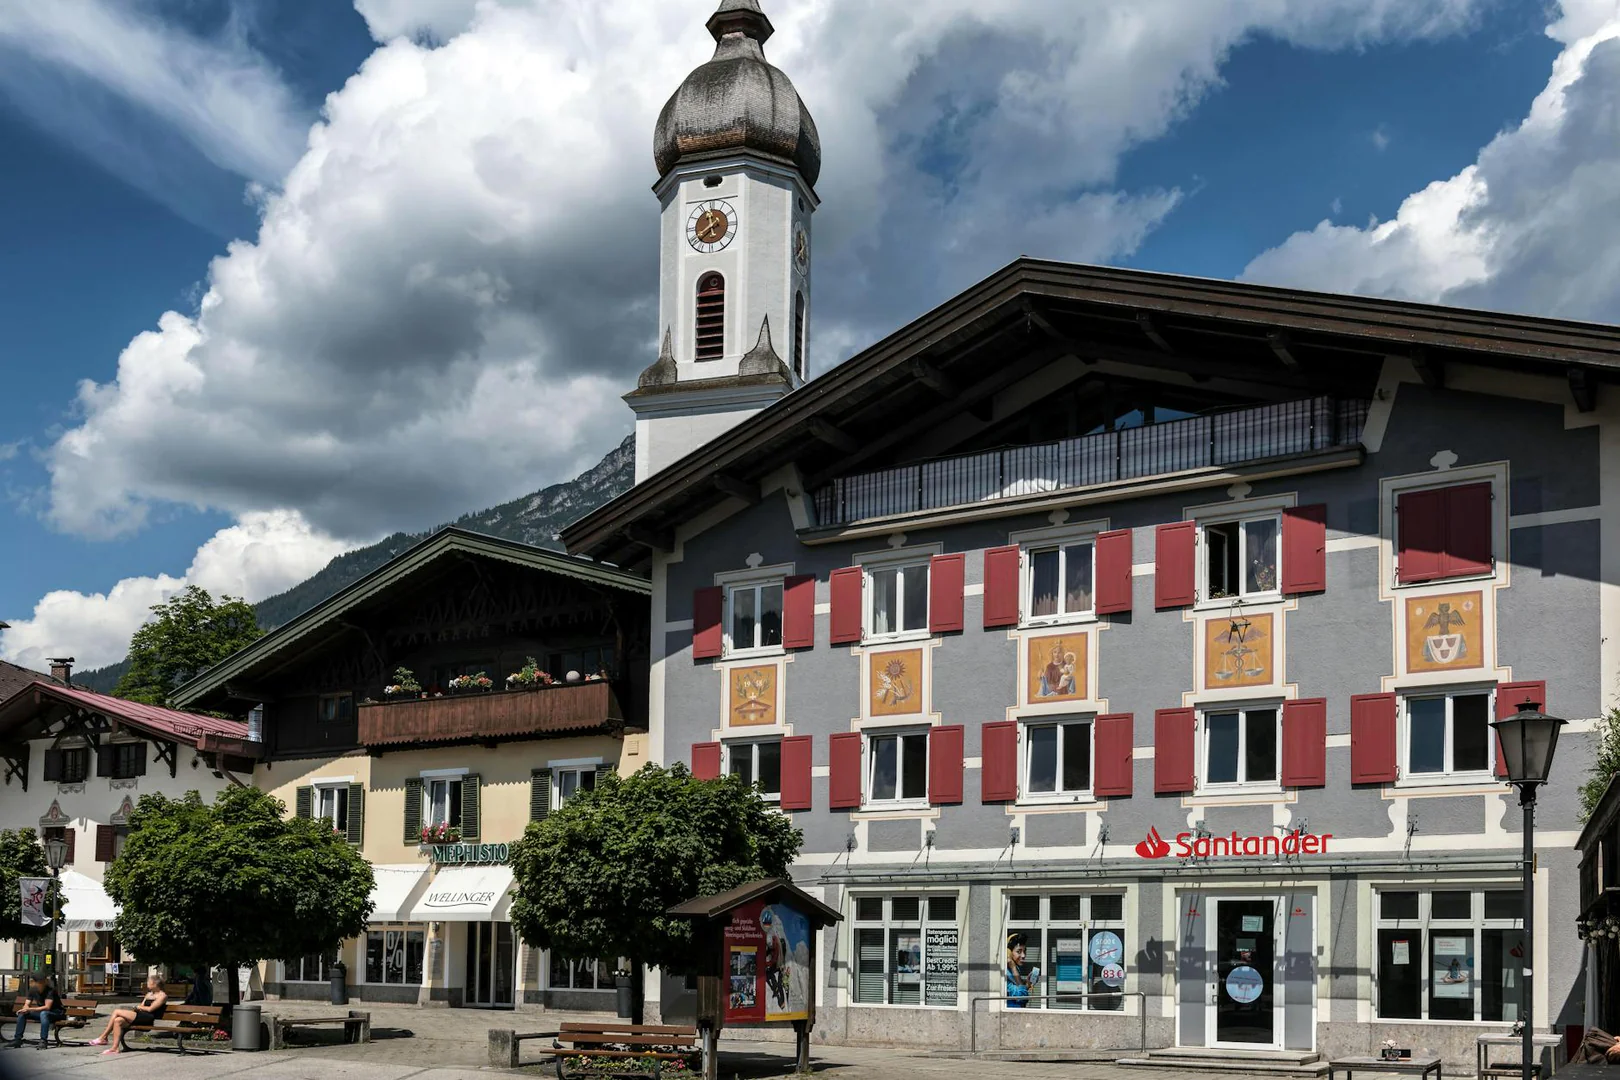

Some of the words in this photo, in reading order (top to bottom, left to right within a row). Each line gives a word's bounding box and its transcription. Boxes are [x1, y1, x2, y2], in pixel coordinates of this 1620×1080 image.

[1176, 829, 1333, 857] Santander
[432, 843, 508, 862] MEPHISTO
[428, 891, 495, 903] WELLINGER
[926, 935, 957, 945] möglich
[926, 963, 936, 971] Ab
[937, 963, 957, 971] 1,99%
[926, 983, 936, 991] Zur
